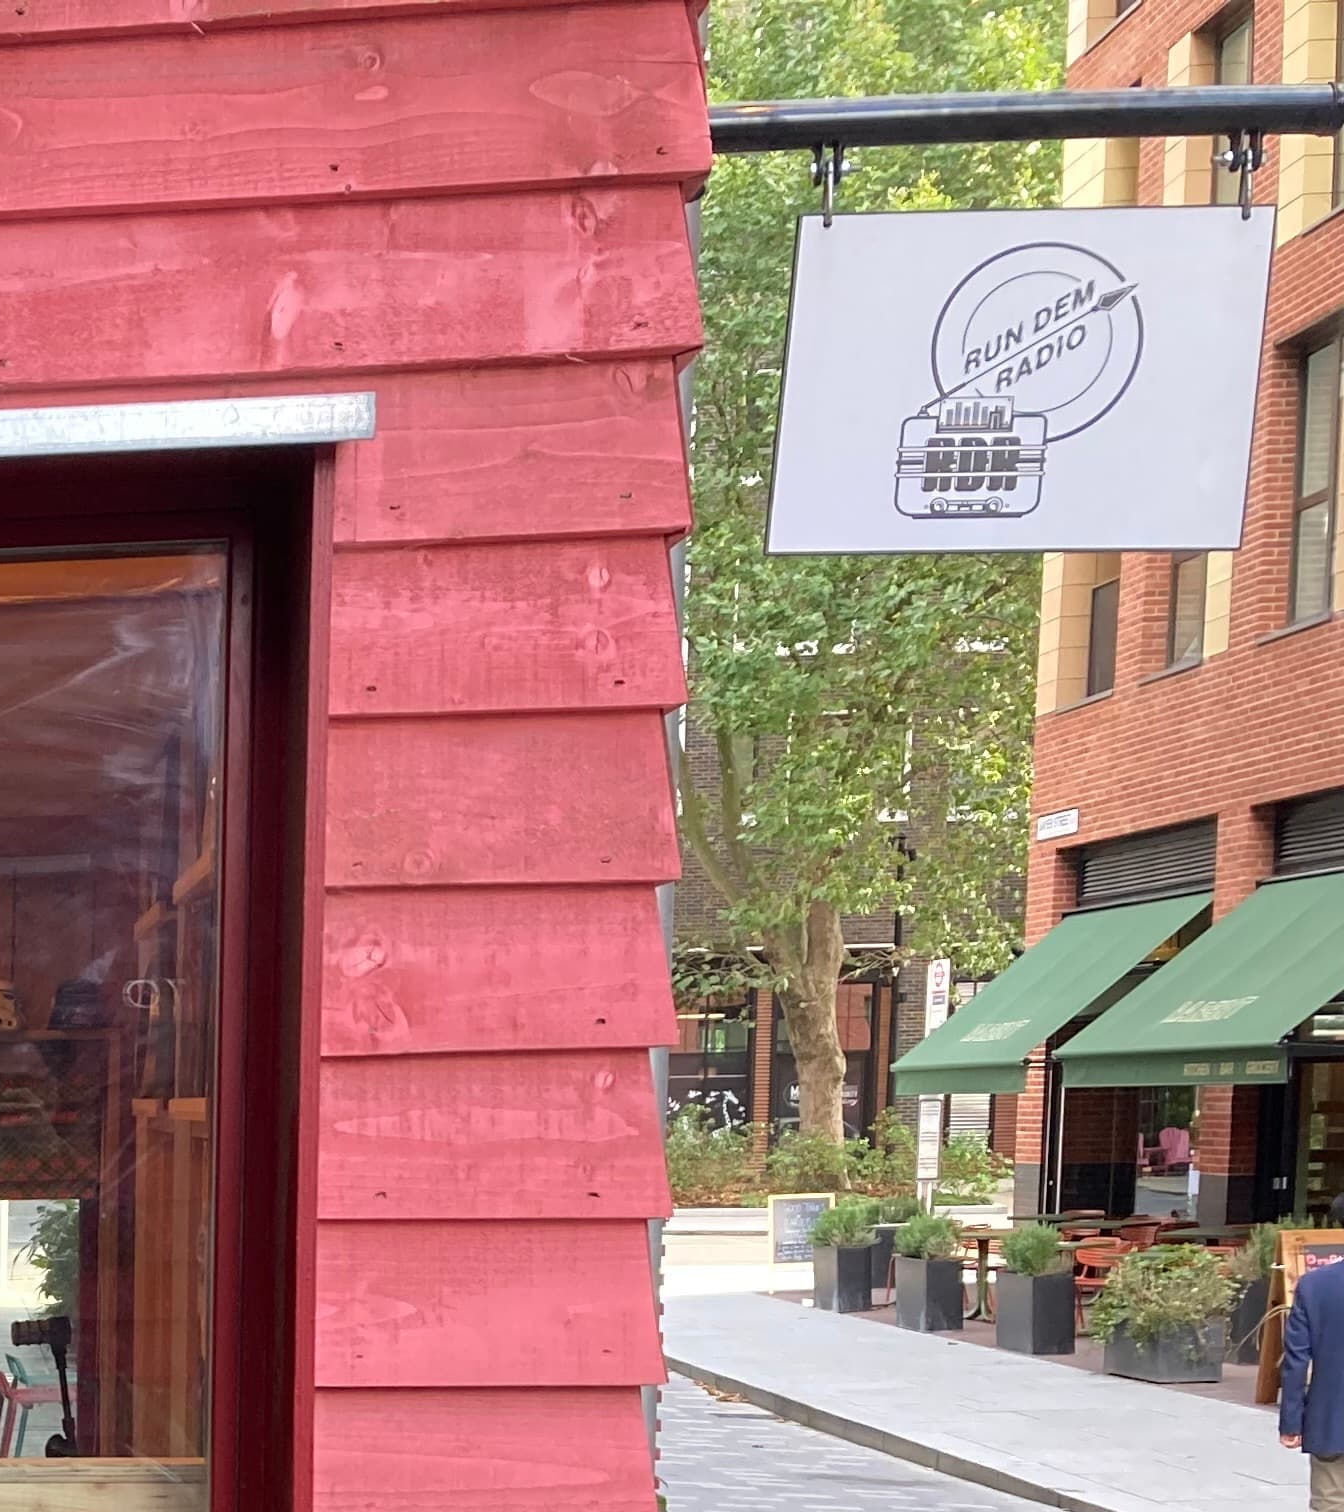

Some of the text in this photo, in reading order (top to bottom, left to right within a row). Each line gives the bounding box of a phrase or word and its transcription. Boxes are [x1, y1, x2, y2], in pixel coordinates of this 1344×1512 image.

[965, 280, 1095, 374] RUN DEM
[996, 325, 1086, 393] RADIO
